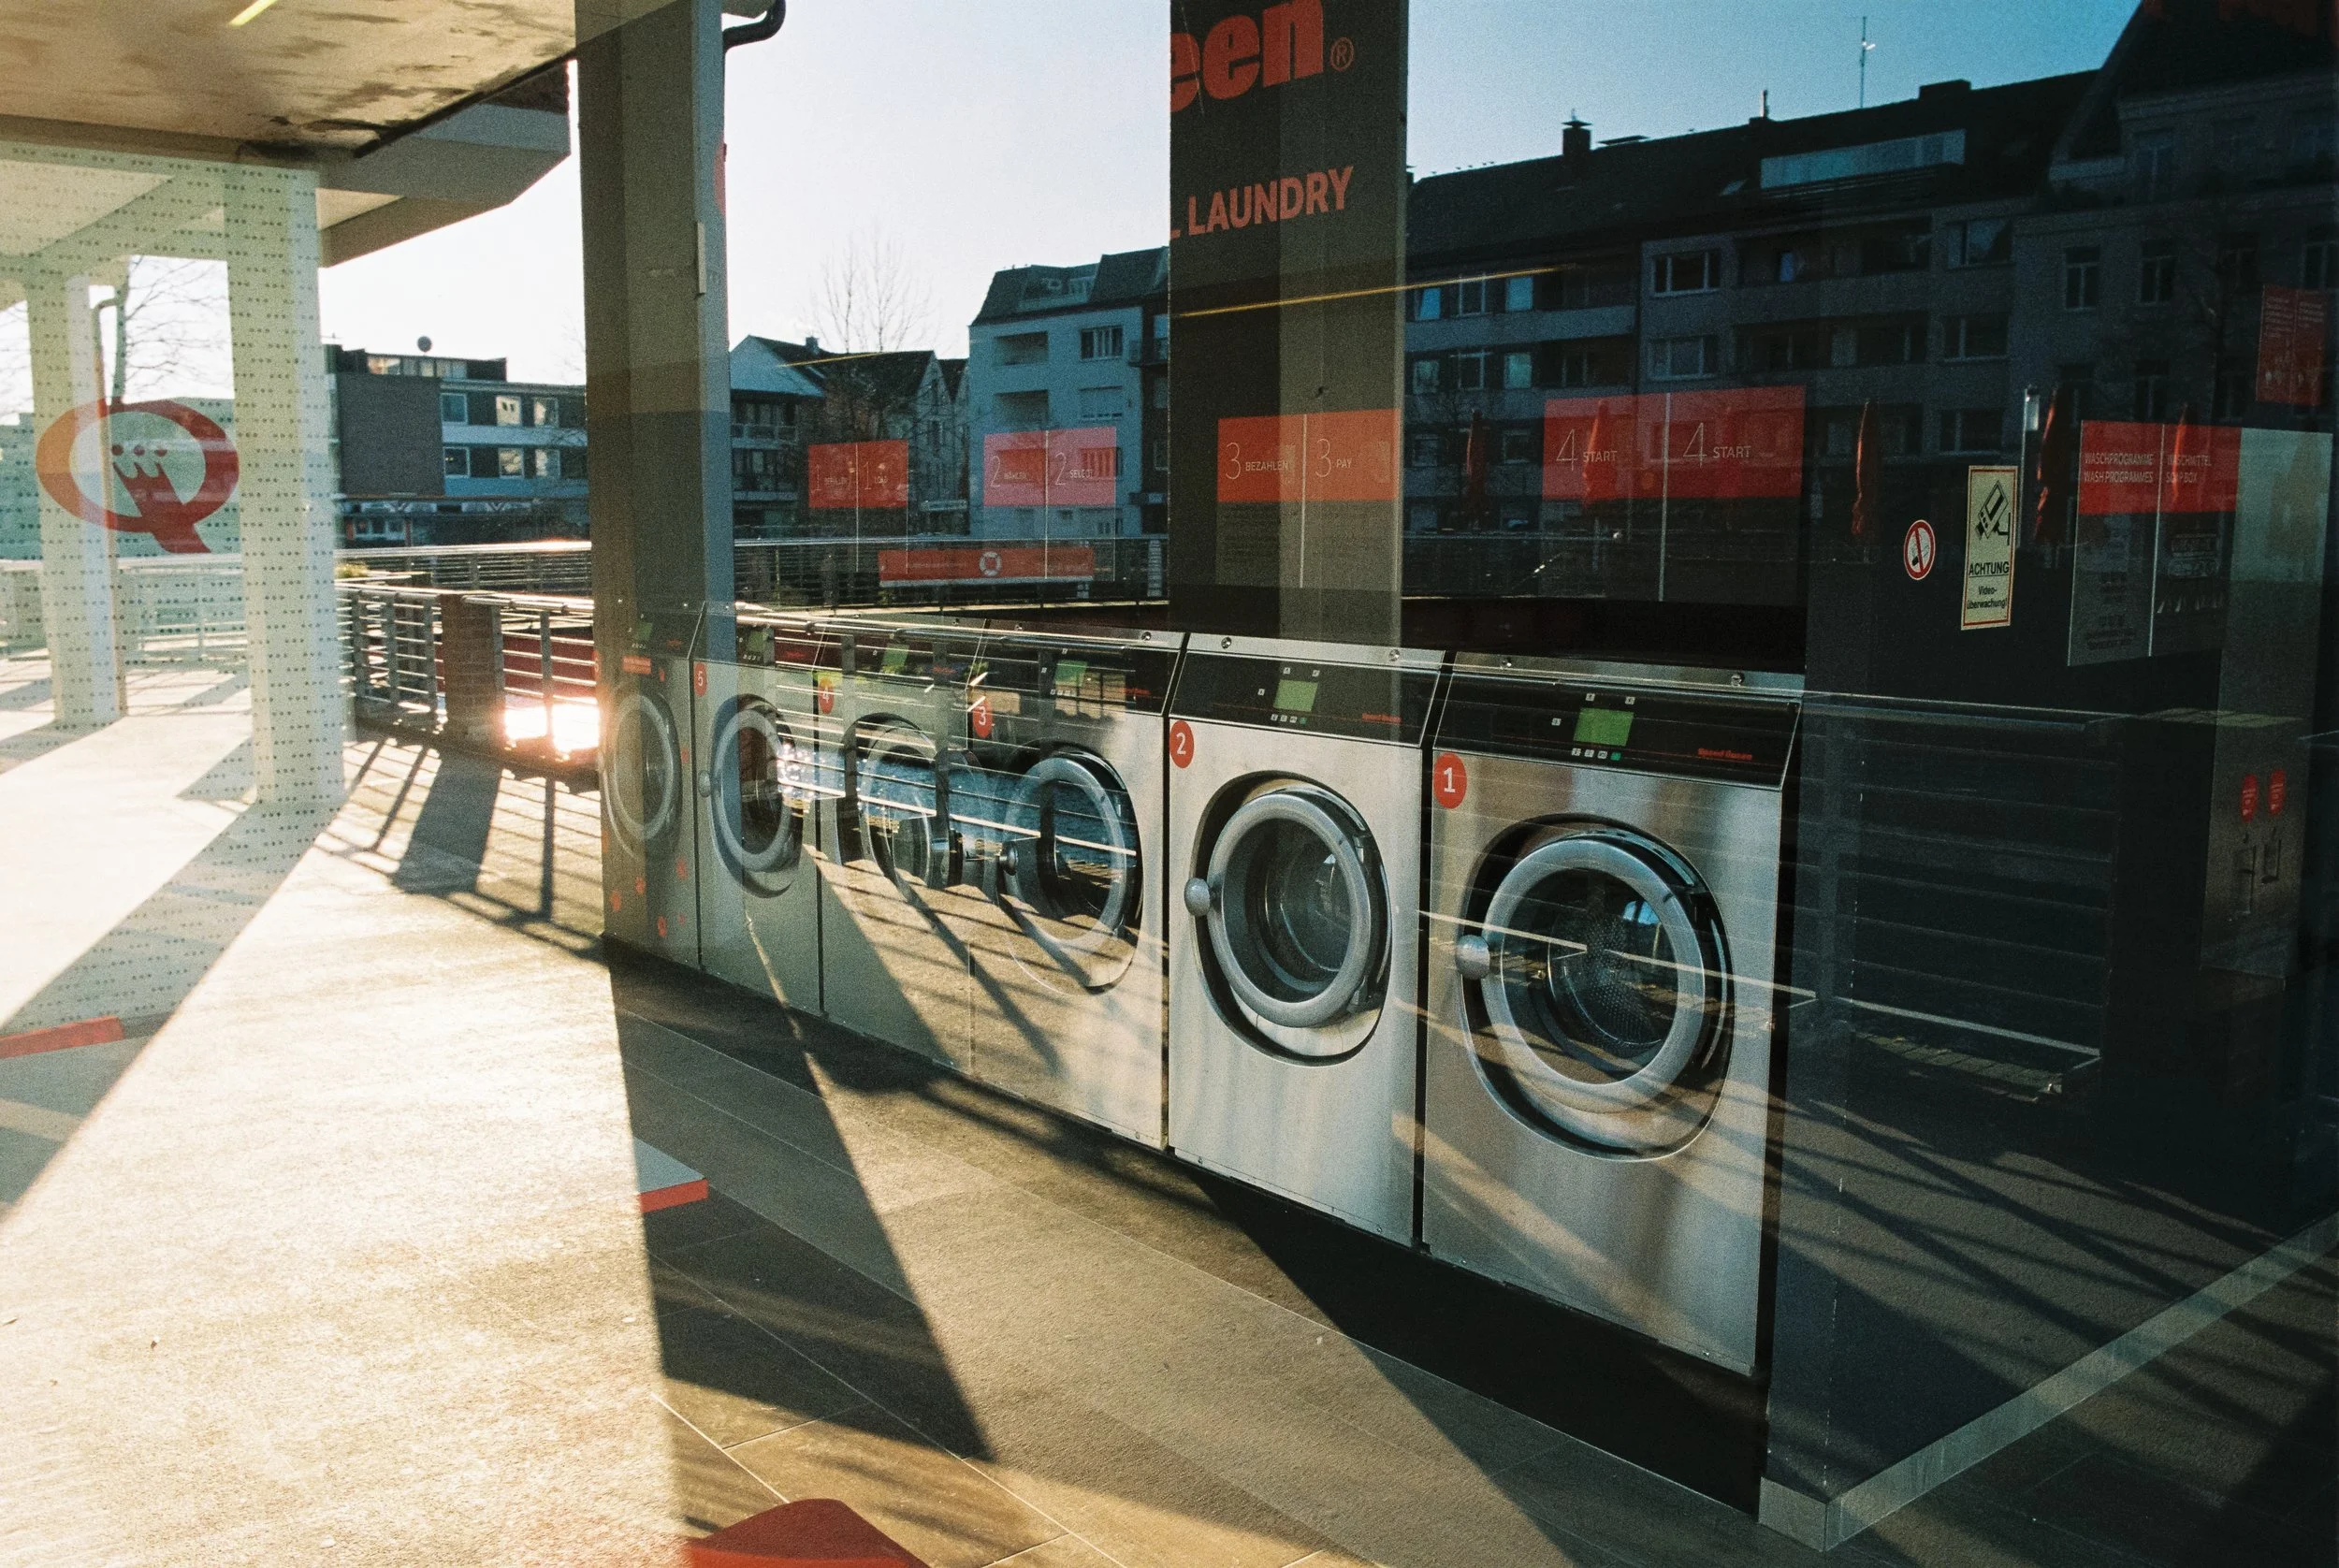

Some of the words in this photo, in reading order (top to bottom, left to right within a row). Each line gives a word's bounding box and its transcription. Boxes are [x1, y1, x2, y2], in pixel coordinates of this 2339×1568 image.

[1187, 166, 1354, 236] LAUNDRY
[1315, 438, 1331, 477] 3
[1336, 458, 1353, 469] PAY
[1556, 428, 1577, 471] 4
[1582, 449, 1618, 462] START
[1683, 422, 1707, 468] 4
[1712, 445, 1751, 458] START
[991, 455, 1001, 486] 2
[1054, 452, 1067, 485] 2
[1226, 442, 1241, 479] 3
[1245, 460, 1289, 472] BEZAHLEN
[2084, 452, 2154, 465] WASCHPROGRAMME
[815, 464, 821, 490] 1
[864, 461, 872, 489] 1
[2084, 471, 2104, 483] WASH
[2105, 471, 2154, 483] PROGRAMMES
[1969, 561, 2010, 575] ACHTUNG
[1978, 586, 1998, 595] Video-
[698, 671, 704, 687] 5
[822, 686, 831, 704] 4
[979, 706, 987, 726] 3
[1176, 733, 1186, 755] 2
[1444, 767, 1455, 793] 1
